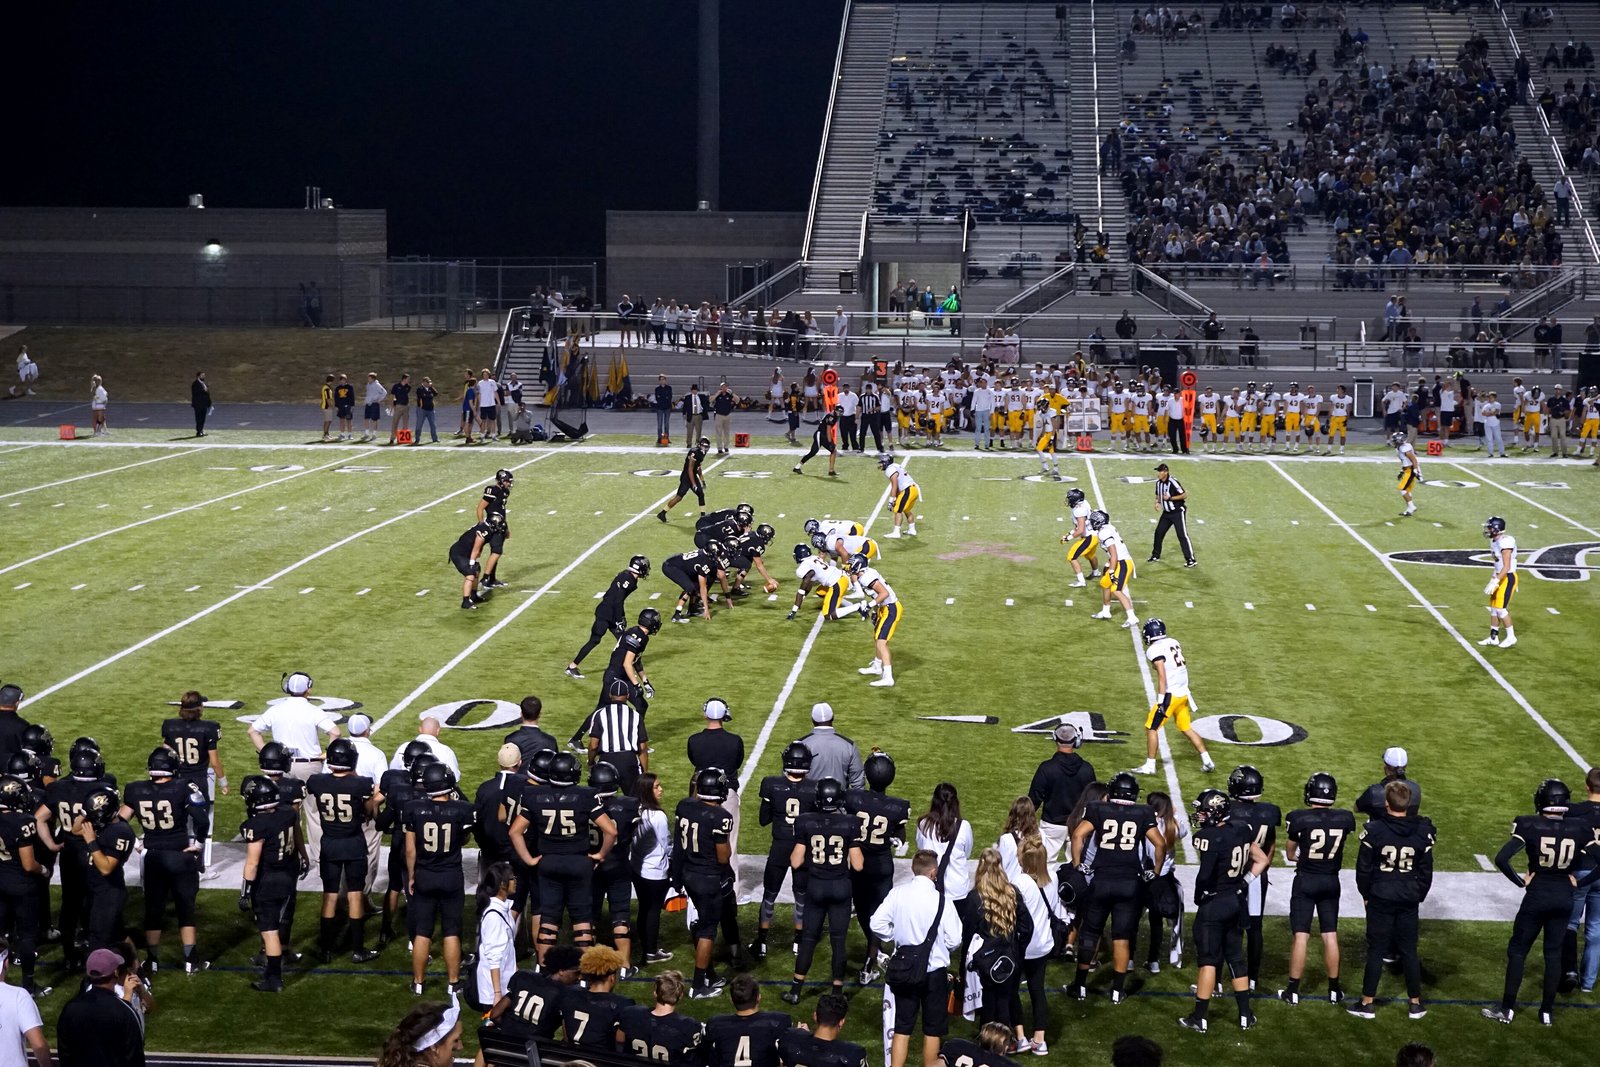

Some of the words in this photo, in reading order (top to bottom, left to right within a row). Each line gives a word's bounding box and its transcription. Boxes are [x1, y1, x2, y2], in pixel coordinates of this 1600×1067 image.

[876, 362, 886, 375] 3
[1114, 398, 1122, 406] 91
[399, 431, 411, 441] 20
[737, 434, 748, 444] 30
[1079, 438, 1090, 448] 40
[1429, 443, 1442, 453] 50
[175, 738, 200, 764] 16
[138, 800, 175, 830] 53
[320, 794, 352, 823] 35
[785, 798, 800, 825] 9
[21, 822, 36, 838] 33
[243, 828, 254, 841] 14
[542, 810, 577, 836] 75
[680, 817, 700, 853] 31
[722, 818, 733, 831] 31
[1100, 818, 1137, 851] 28
[116, 838, 130, 852] 51
[278, 826, 295, 862] 14
[423, 822, 452, 853] 91
[810, 834, 844, 866] 83
[1194, 837, 1209, 852] 90
[1308, 829, 1344, 860] 27
[1228, 842, 1252, 878] 90
[1380, 845, 1416, 873] 36
[1539, 837, 1576, 870] 50
[514, 990, 544, 1026] 10
[574, 1010, 590, 1044] 7
[734, 1036, 752, 1067] 4
